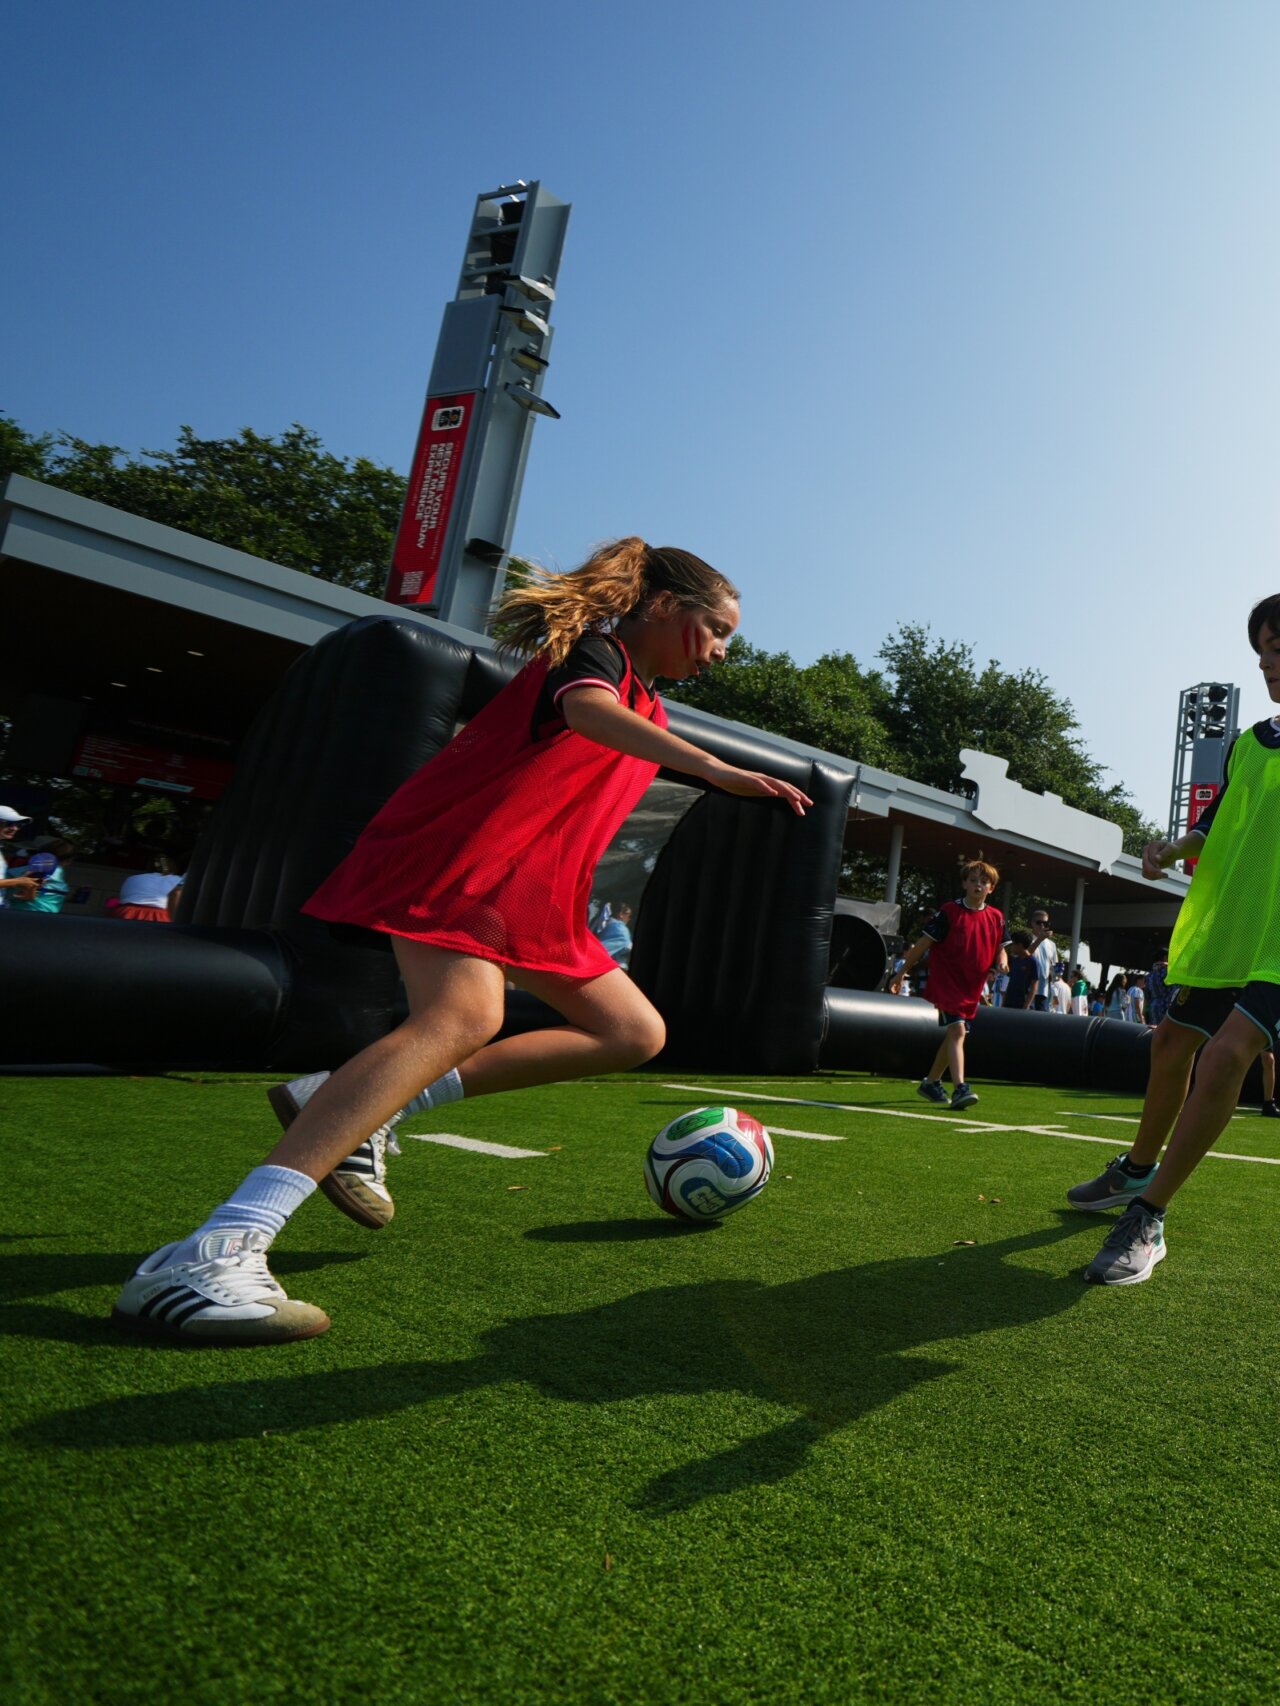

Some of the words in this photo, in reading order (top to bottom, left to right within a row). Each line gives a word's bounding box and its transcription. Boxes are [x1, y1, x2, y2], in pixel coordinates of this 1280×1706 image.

[416, 443, 438, 520] EXPERIENCE
[434, 443, 446, 475] NEXT
[438, 442, 453, 491] SECURE
[417, 478, 437, 548] MATCHDAY
[429, 494, 443, 529] YOUR
